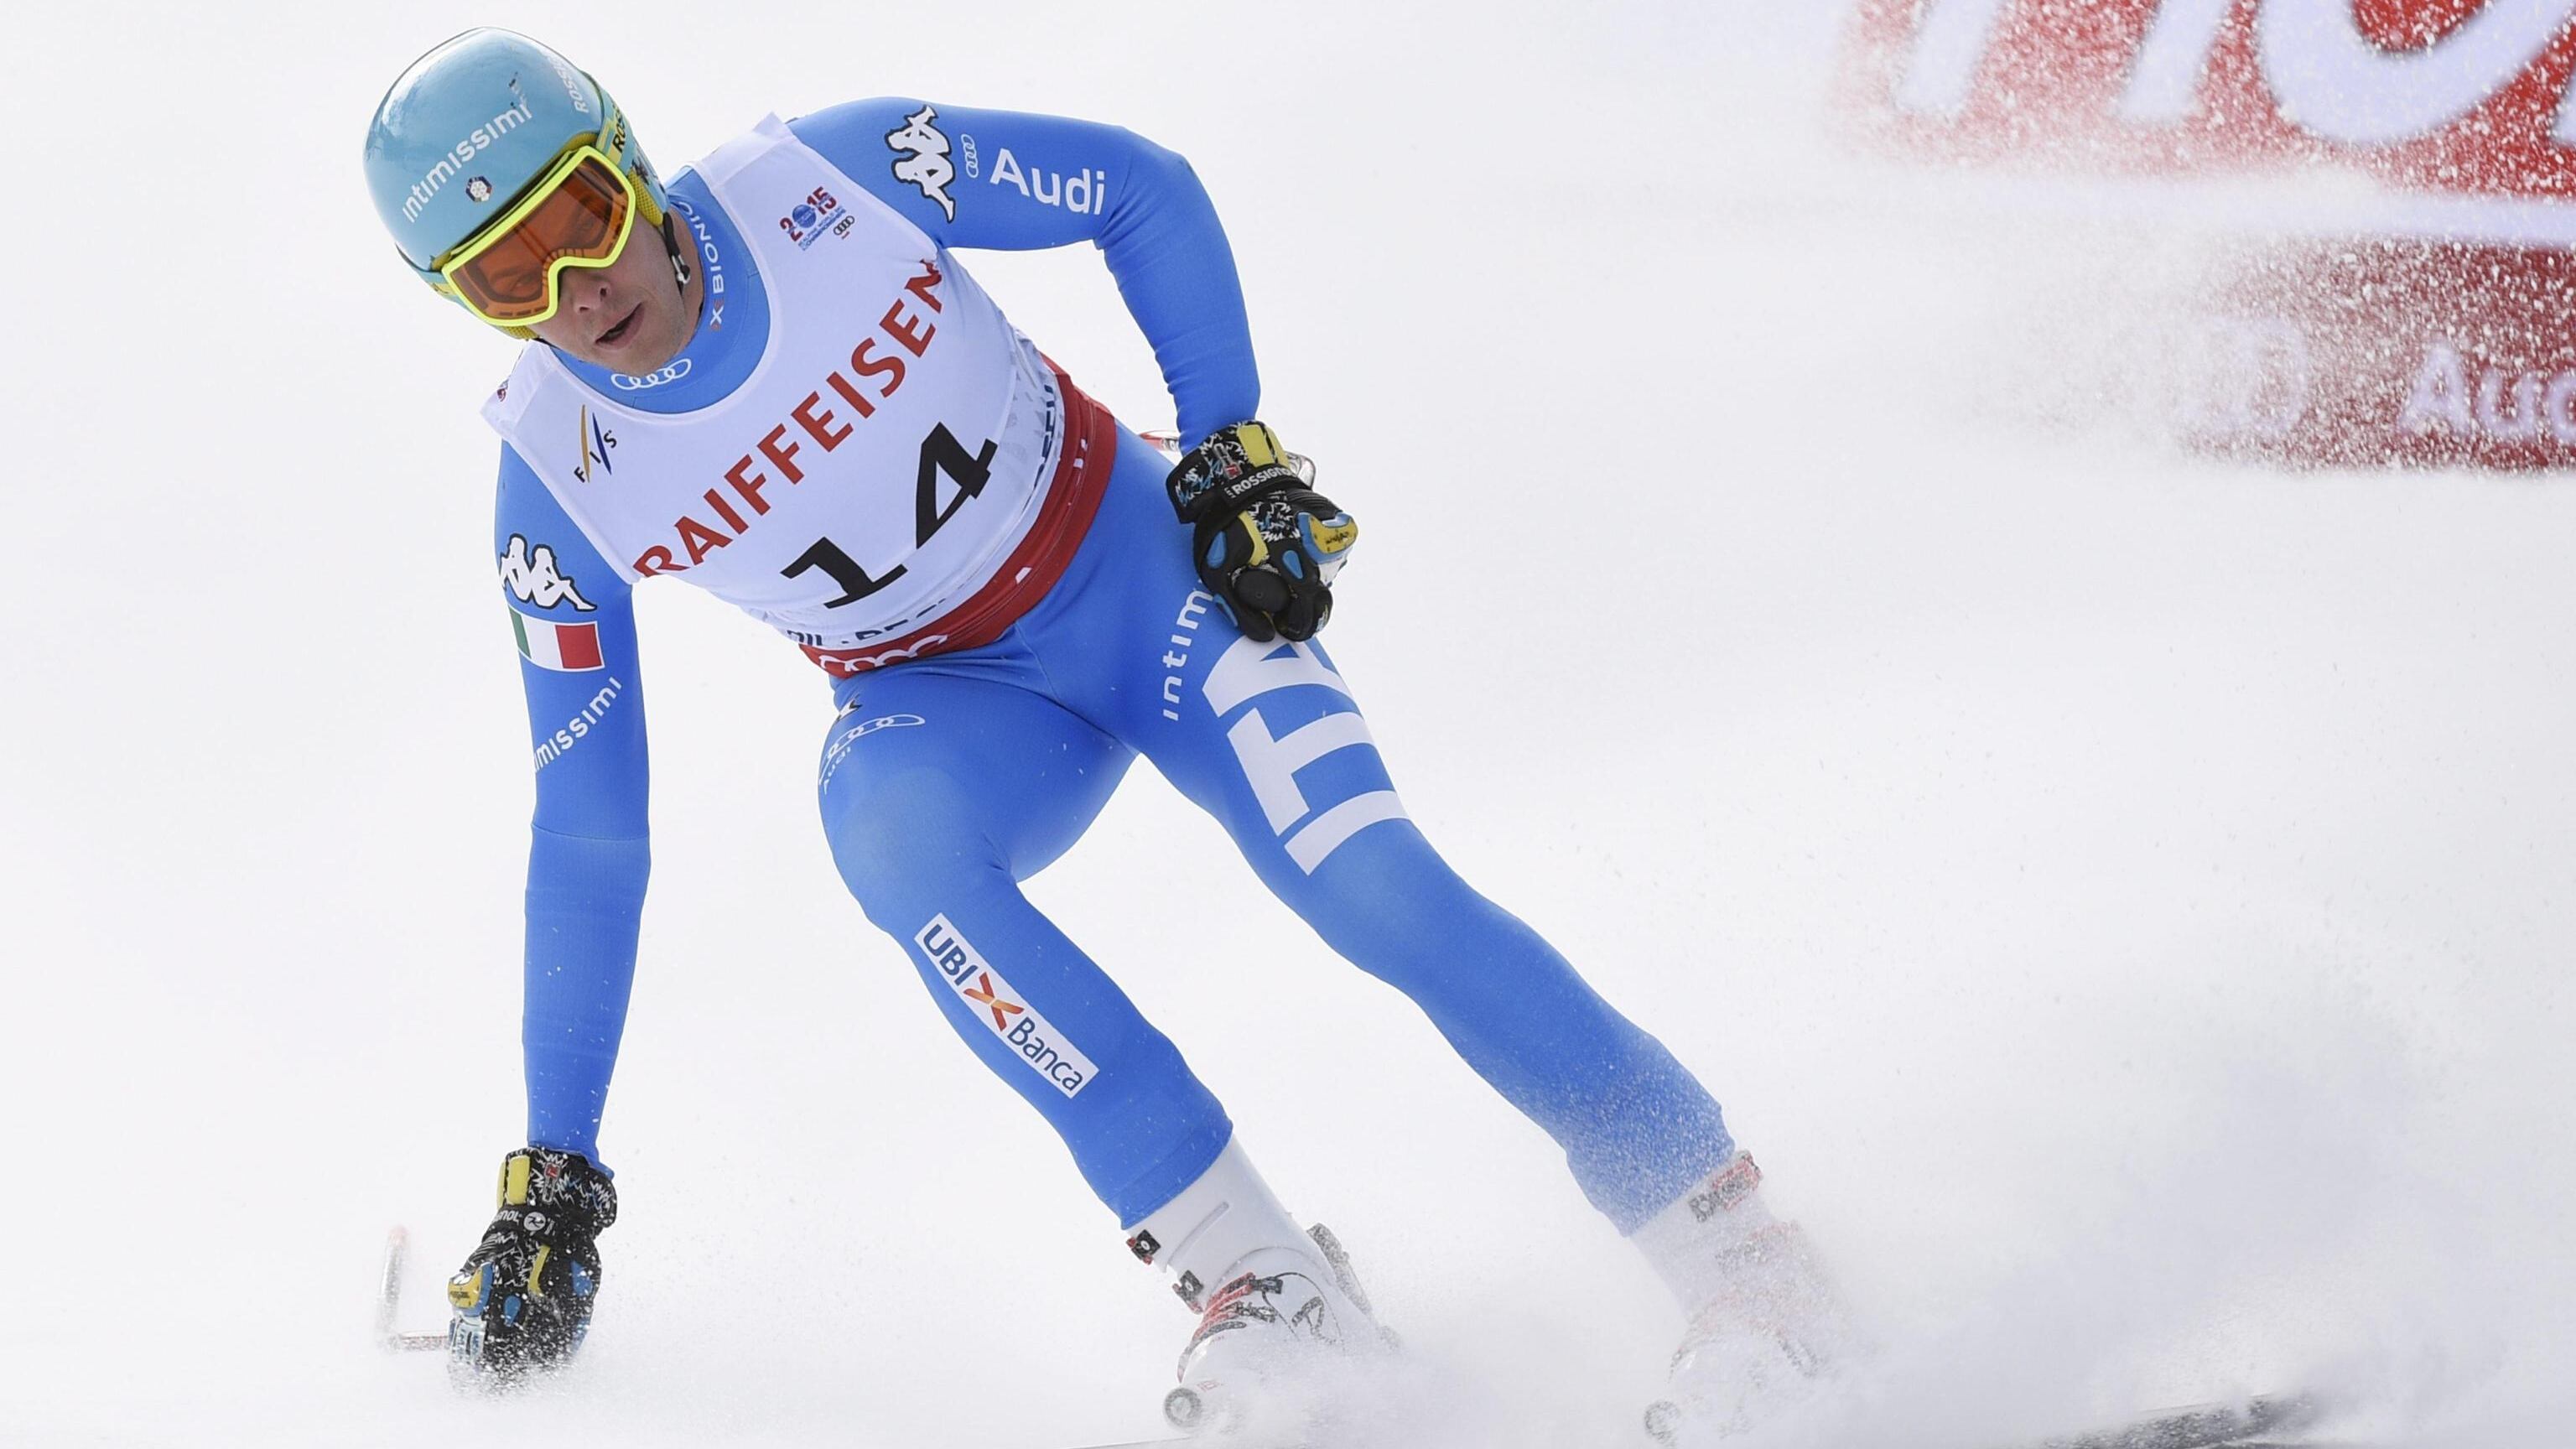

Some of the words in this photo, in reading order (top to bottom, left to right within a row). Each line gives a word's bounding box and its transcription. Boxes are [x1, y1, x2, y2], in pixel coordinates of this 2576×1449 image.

[402, 102, 532, 224] intimissimi
[989, 148, 1105, 216] Audi
[632, 258, 943, 578] RAIFFEISEN
[780, 422, 999, 610] 14
[1162, 586, 1214, 722] intim
[1202, 634, 1410, 877] ITA
[923, 923, 979, 986] UBI
[1006, 1016, 1083, 1091] Banca
